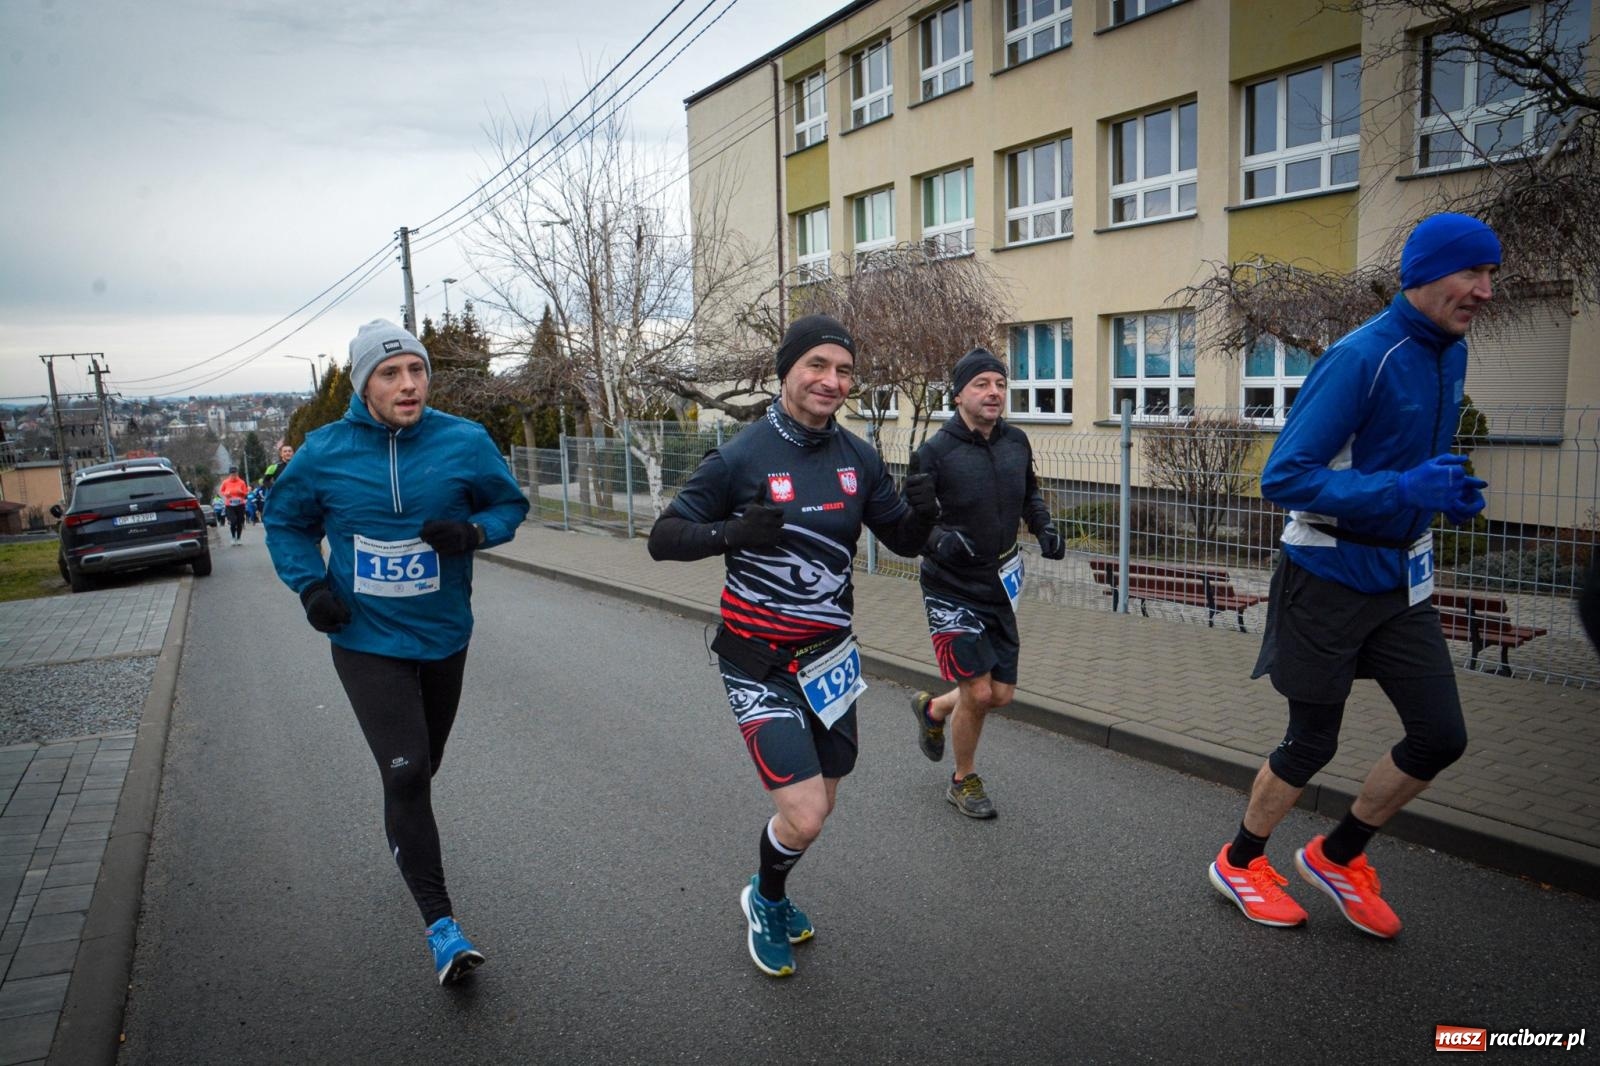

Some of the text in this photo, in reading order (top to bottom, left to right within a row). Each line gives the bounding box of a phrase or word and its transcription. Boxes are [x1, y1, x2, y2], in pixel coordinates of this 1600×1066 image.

[369, 554, 425, 581] 156
[1420, 549, 1433, 580] 1
[817, 657, 856, 704] 193
